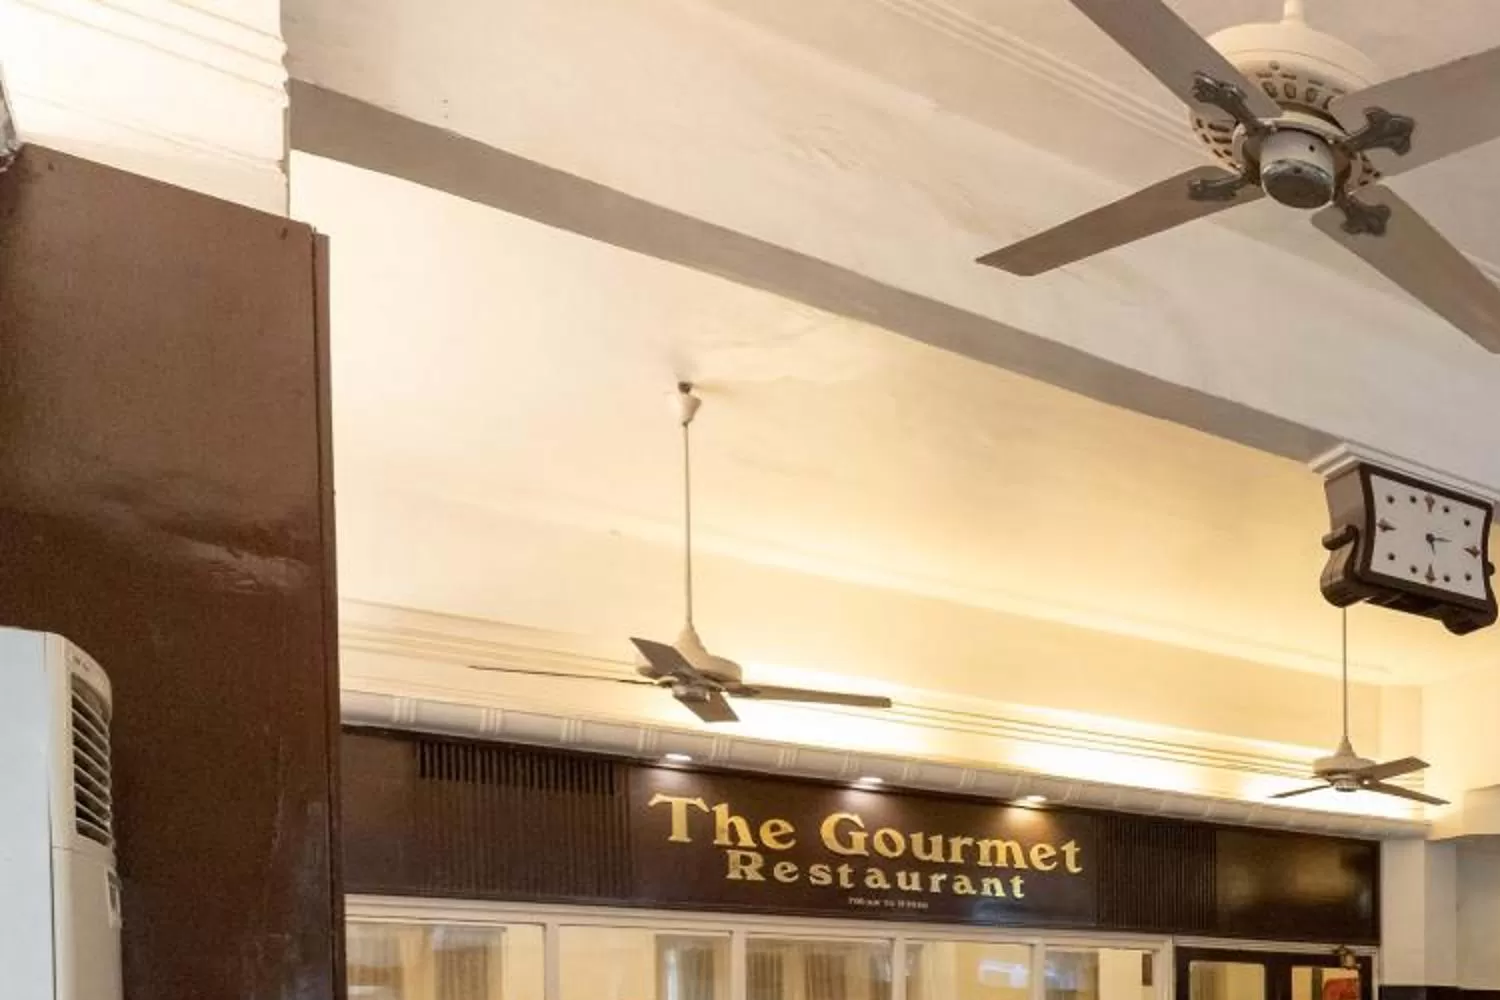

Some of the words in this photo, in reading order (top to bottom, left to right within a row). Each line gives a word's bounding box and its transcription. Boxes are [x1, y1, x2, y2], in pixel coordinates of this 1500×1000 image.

[648, 793, 797, 850] The
[819, 812, 1083, 874] Gourmet
[726, 850, 1025, 899] Restaurant
